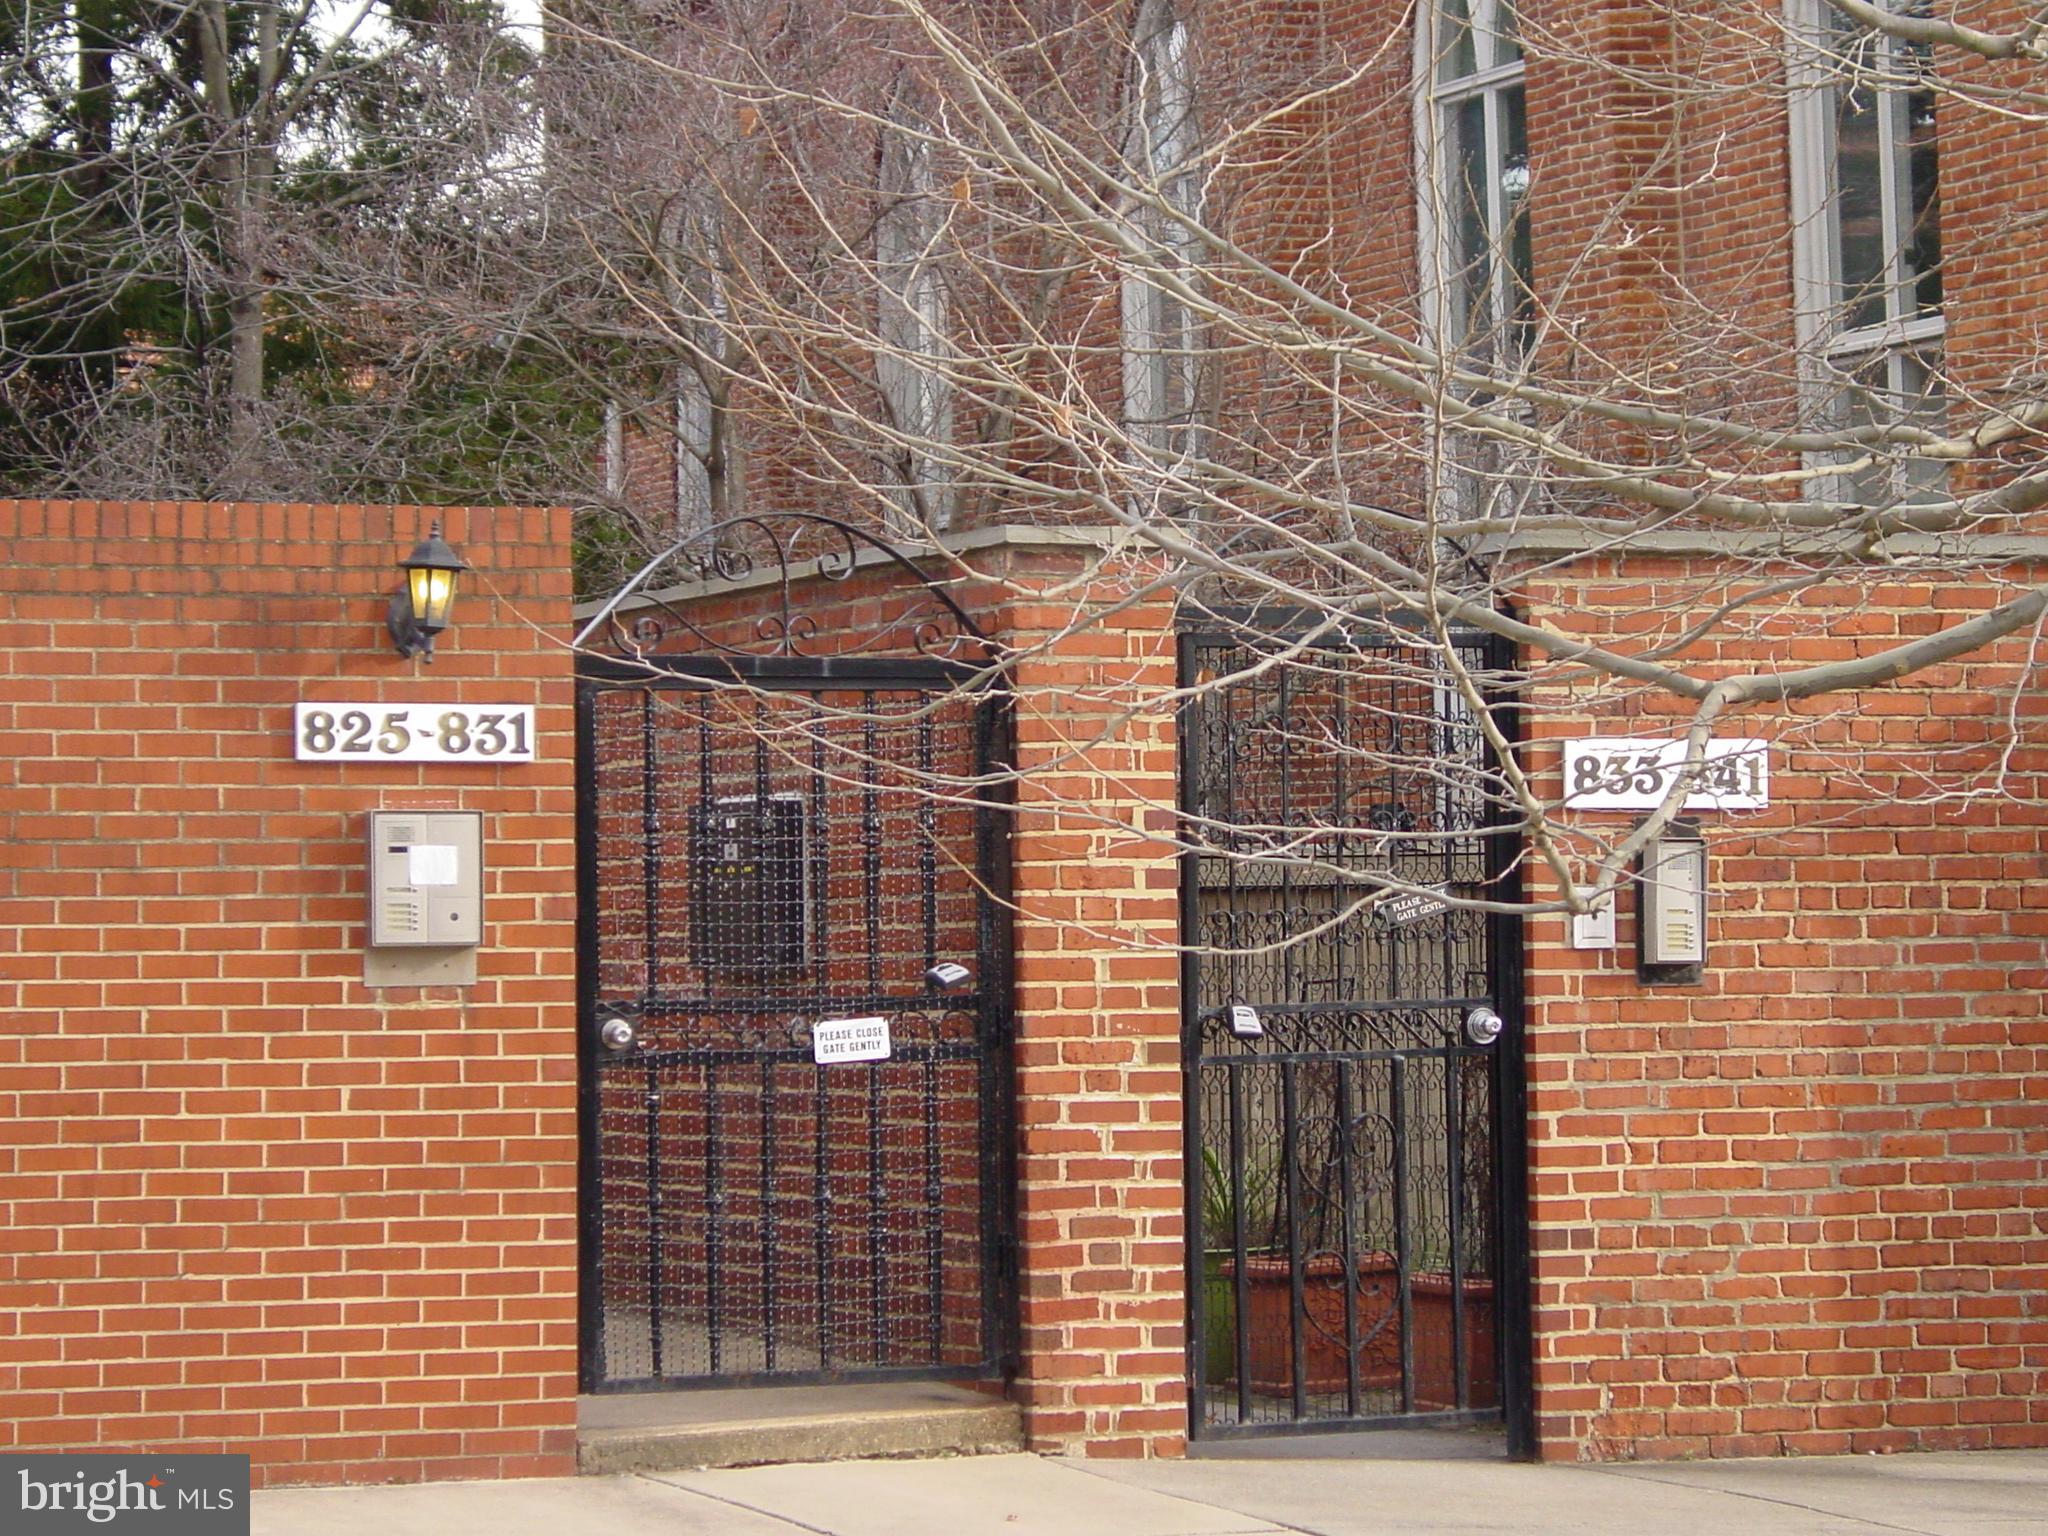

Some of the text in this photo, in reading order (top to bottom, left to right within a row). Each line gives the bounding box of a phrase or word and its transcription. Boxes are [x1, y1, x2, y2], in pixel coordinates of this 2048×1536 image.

[303, 710, 530, 755] 825-831
[1392, 895, 1422, 912] PLEASE
[1397, 900, 1447, 922] GATE GENTL
[819, 1026, 884, 1041] PLEASE CLOSE
[823, 1040, 881, 1054] GATE GENTLY
